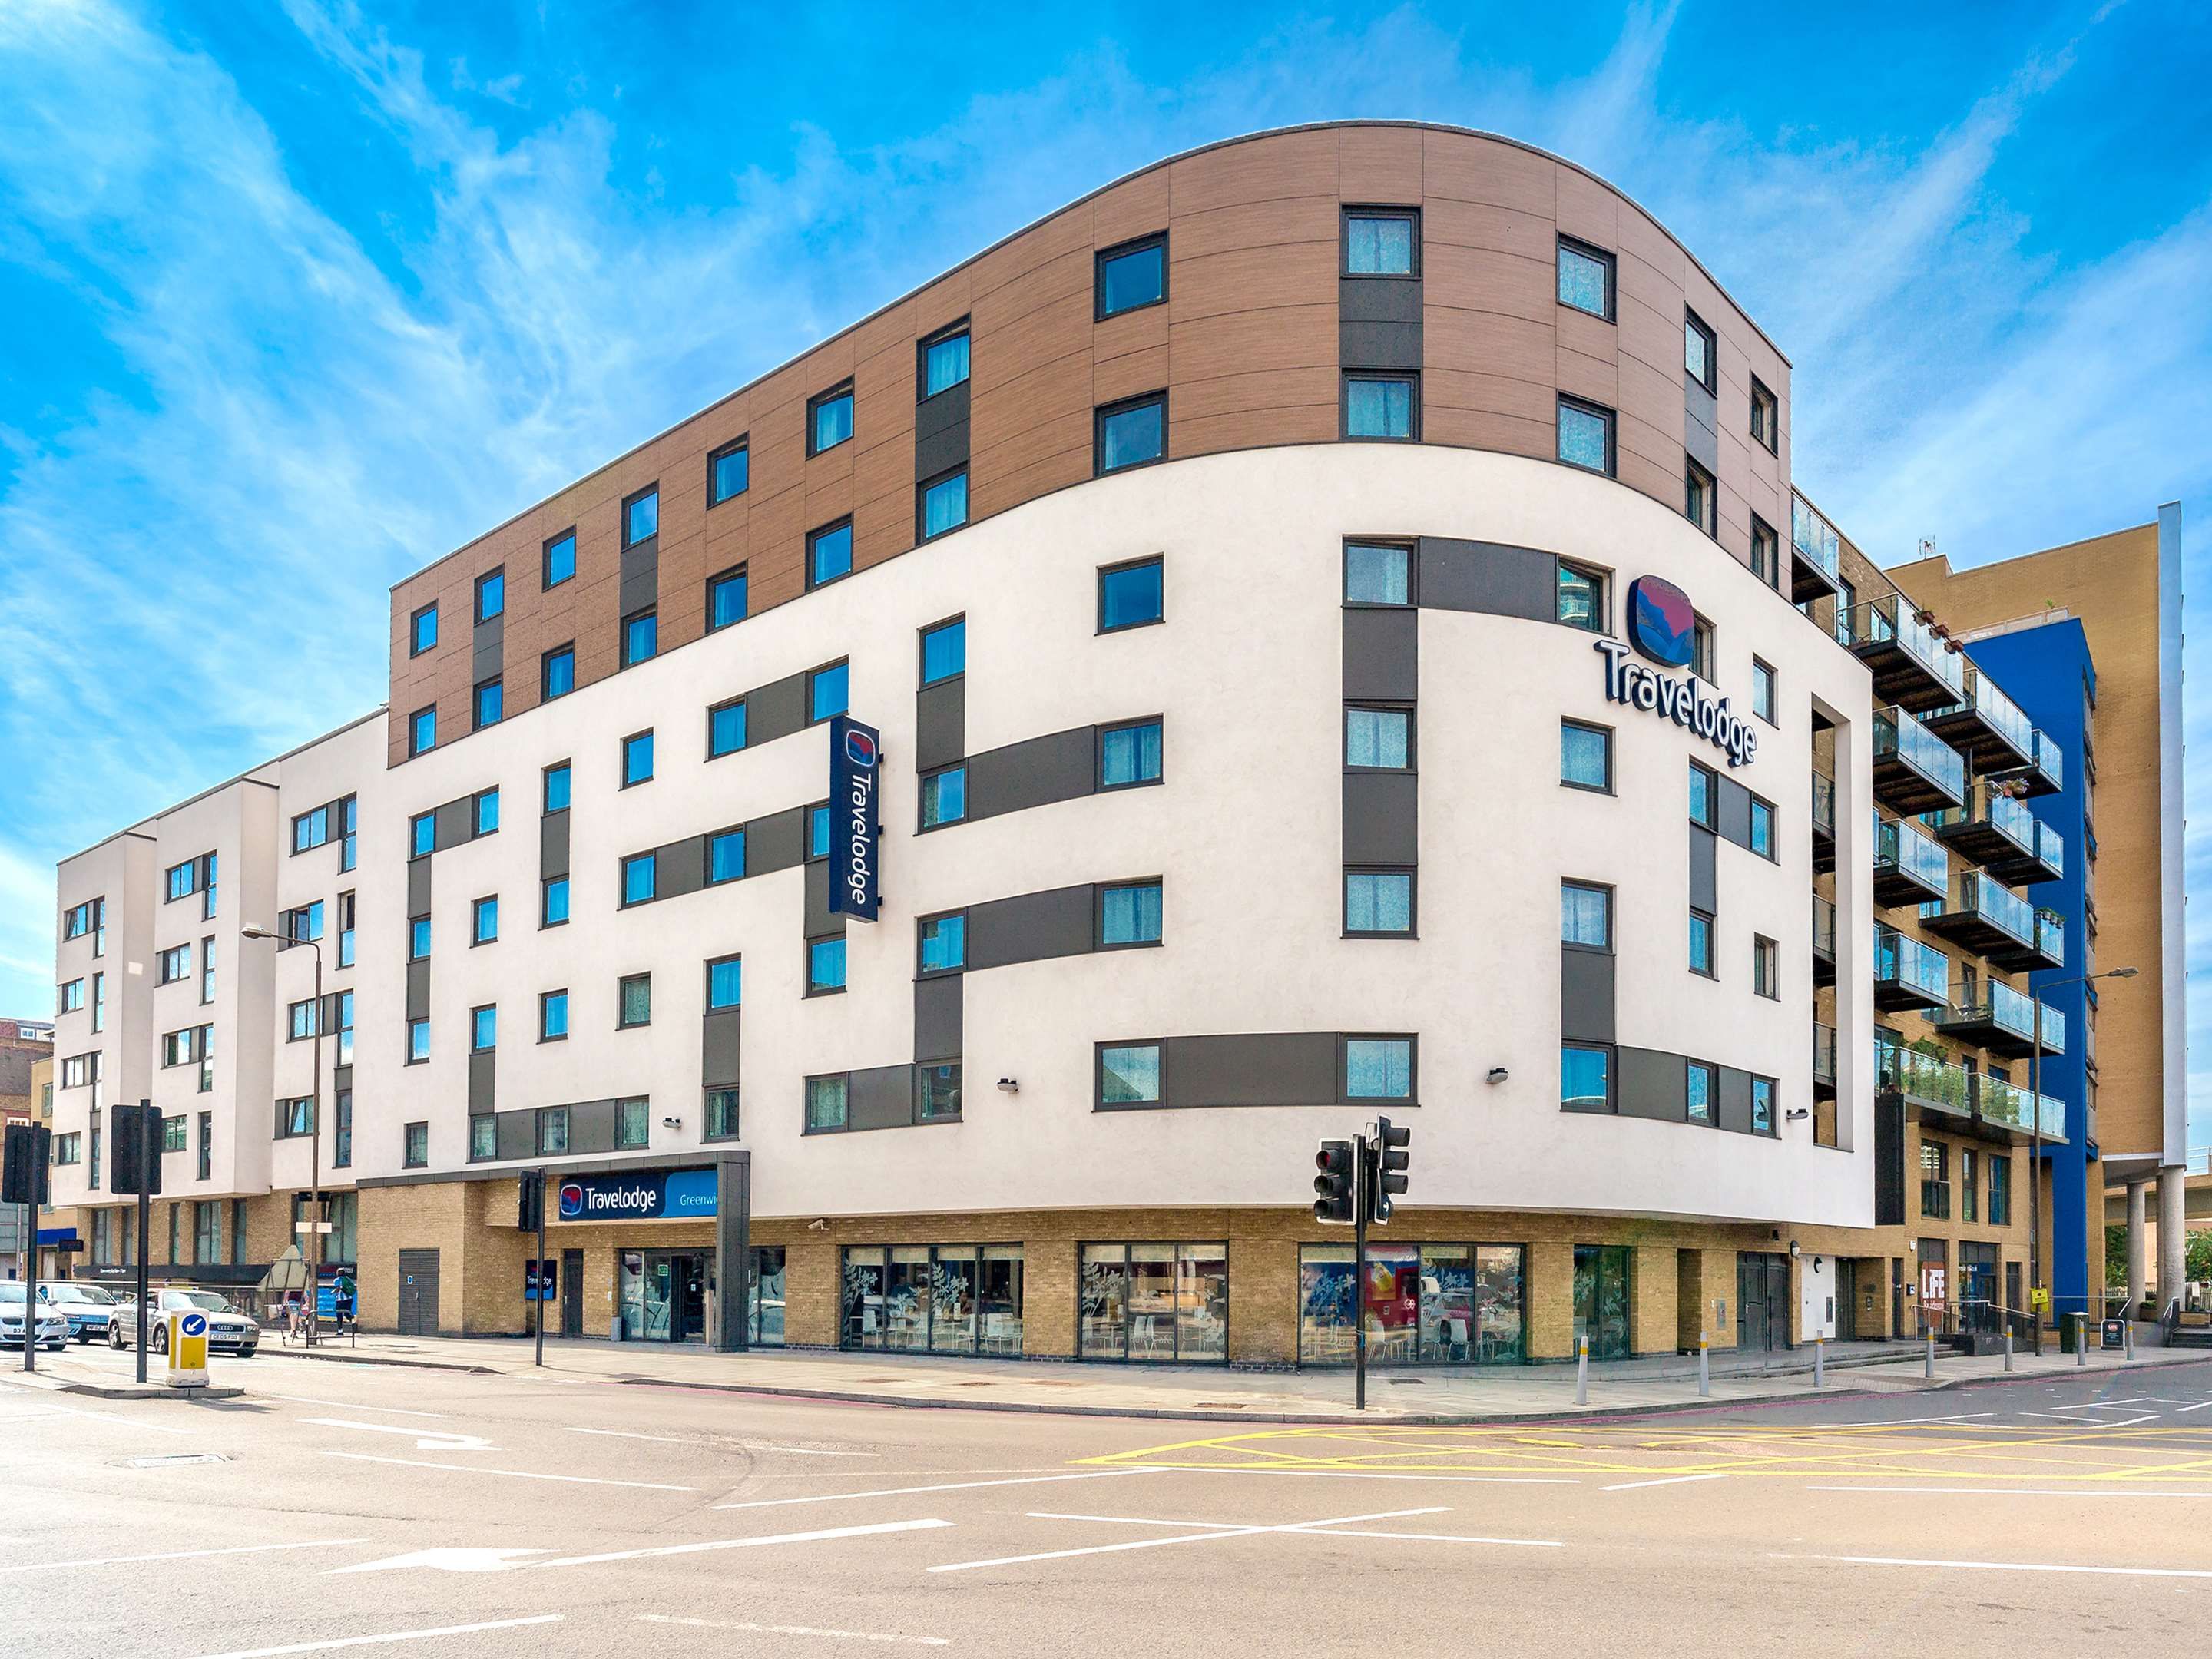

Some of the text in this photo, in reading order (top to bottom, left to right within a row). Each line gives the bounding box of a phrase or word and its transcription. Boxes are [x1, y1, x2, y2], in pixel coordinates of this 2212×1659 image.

[1593, 640, 1757, 767] Travelodge
[847, 773, 872, 905] Travelodge
[585, 1185, 718, 1213] Travelodge Greenwi
[527, 1275, 552, 1286] Travdge
